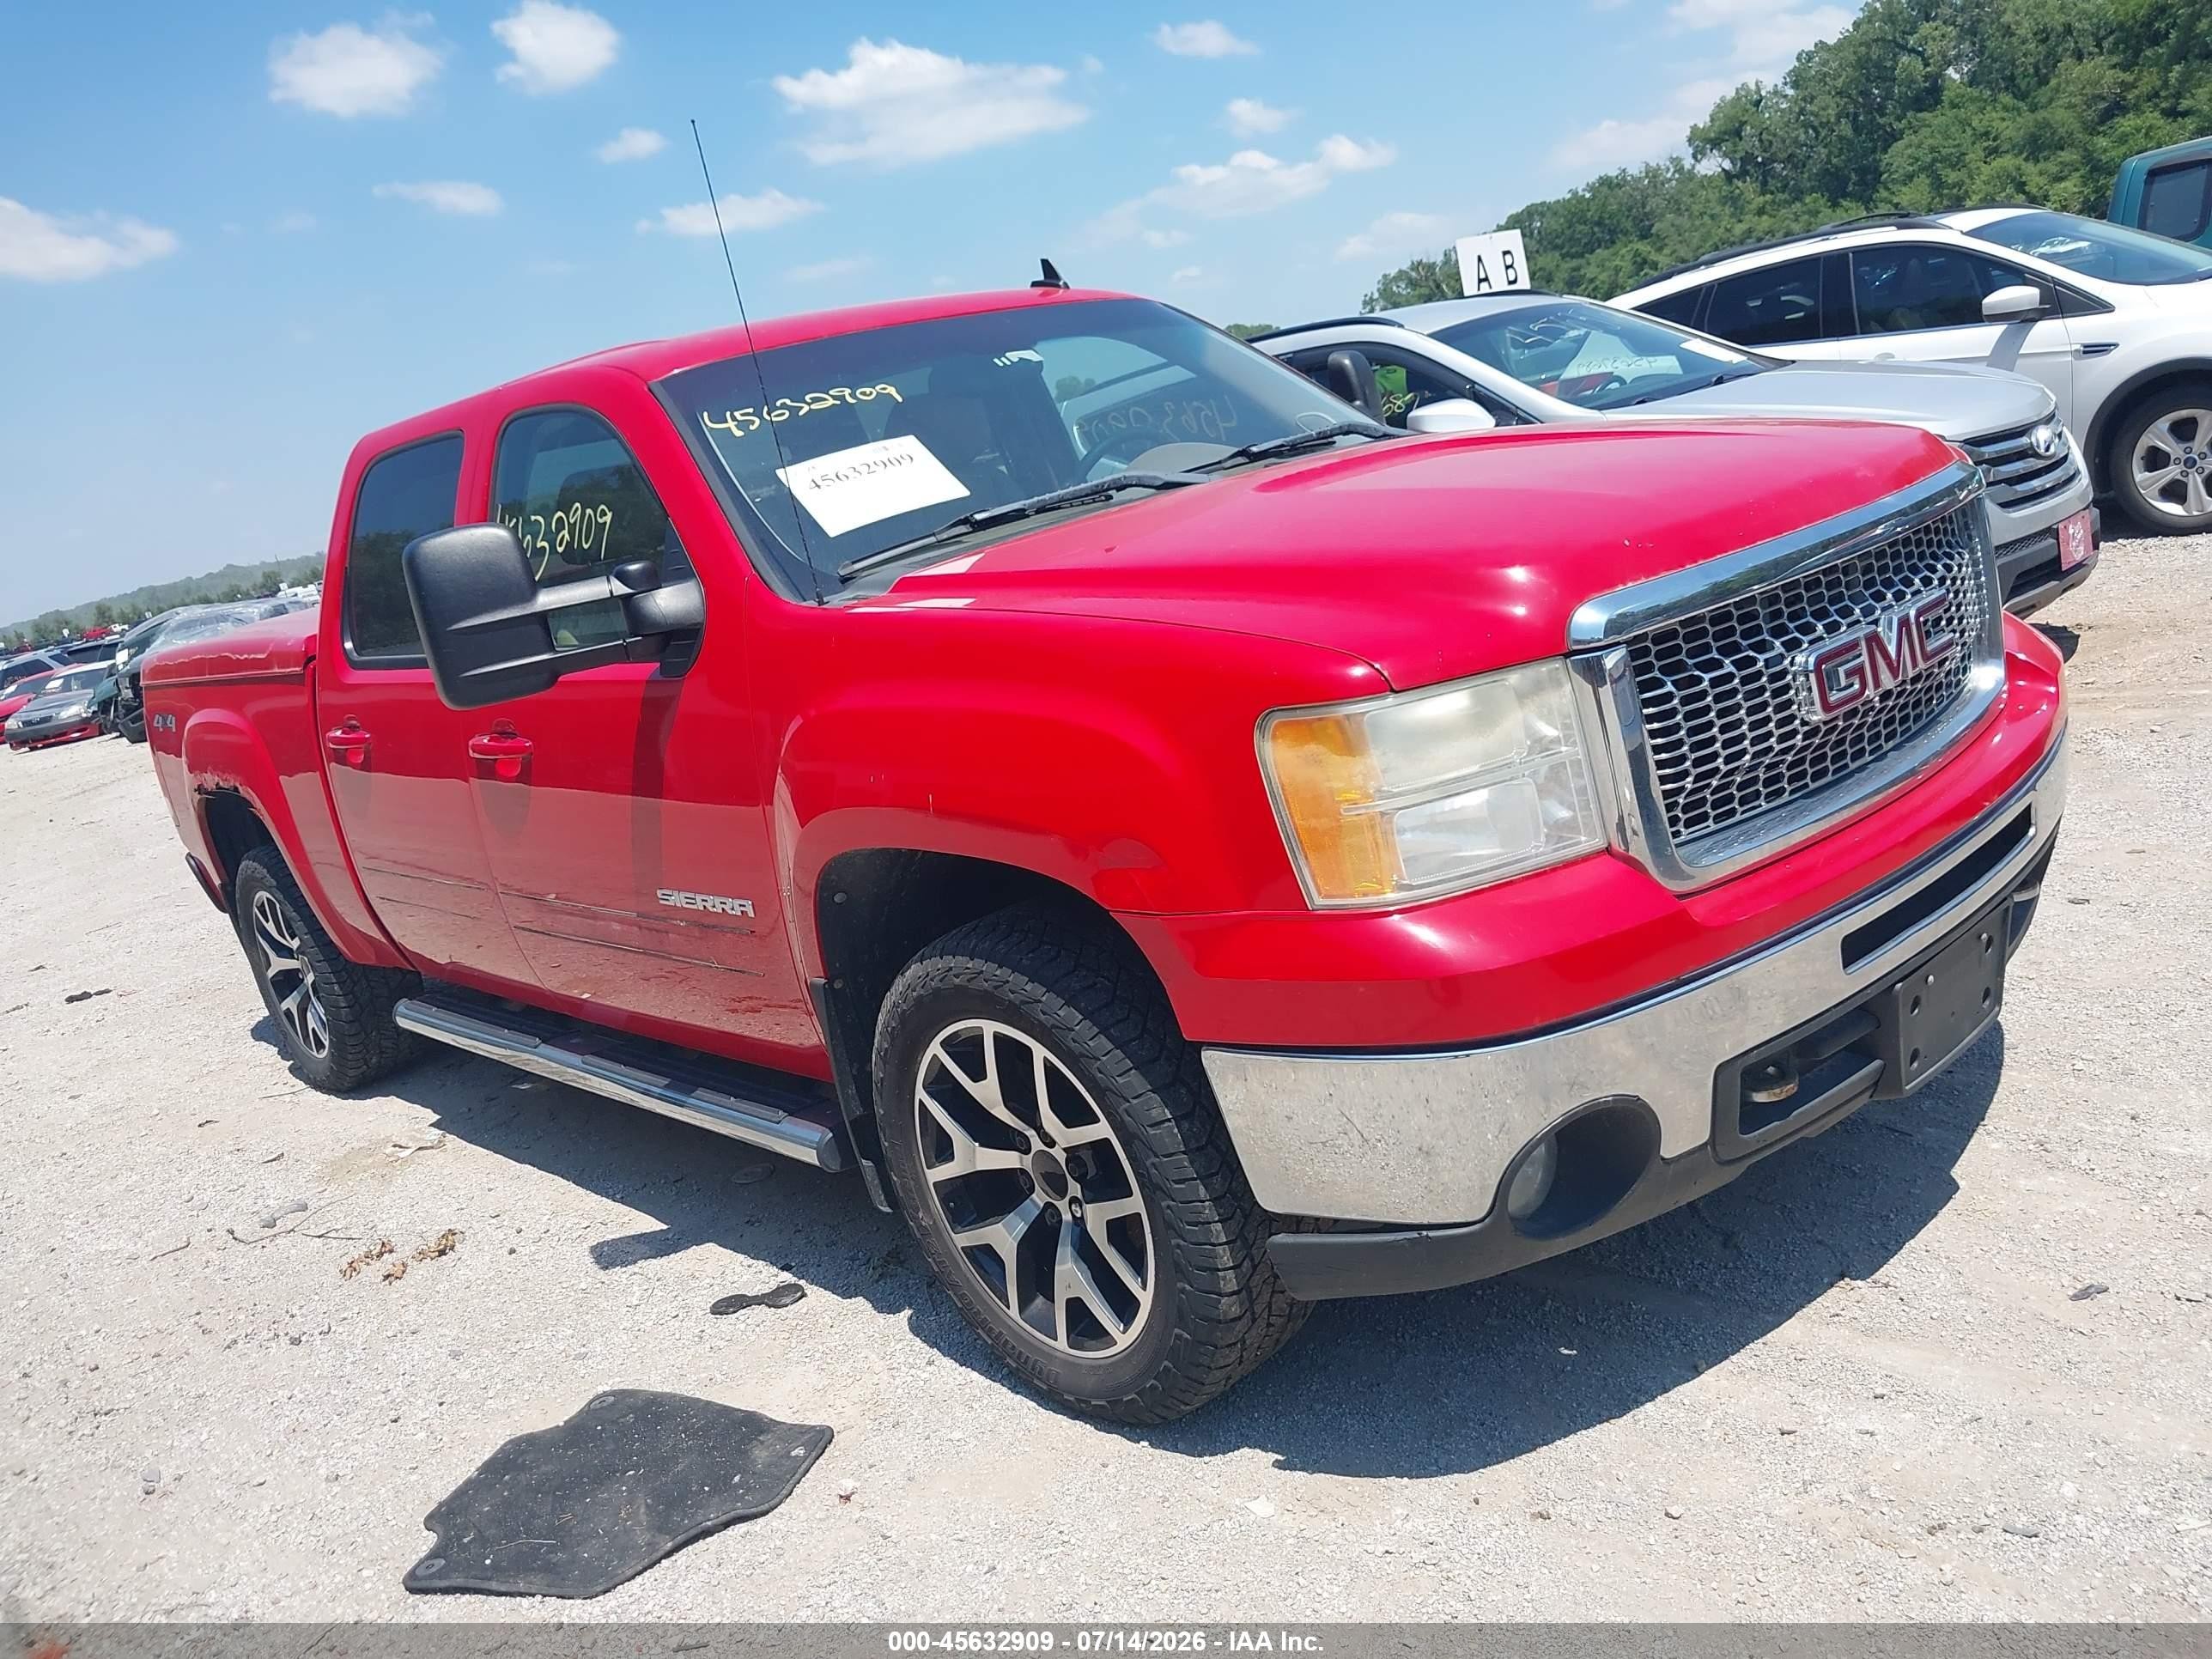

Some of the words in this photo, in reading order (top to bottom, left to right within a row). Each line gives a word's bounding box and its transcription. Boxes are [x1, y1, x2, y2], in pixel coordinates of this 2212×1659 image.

[1476, 254, 1492, 292] A
[1501, 249, 1518, 286] B
[702, 383, 904, 437] 45632909
[808, 453, 915, 490] 45632909
[495, 501, 613, 582] 632909
[1805, 588, 1959, 720] GMC
[656, 887, 756, 918] SIERRA
